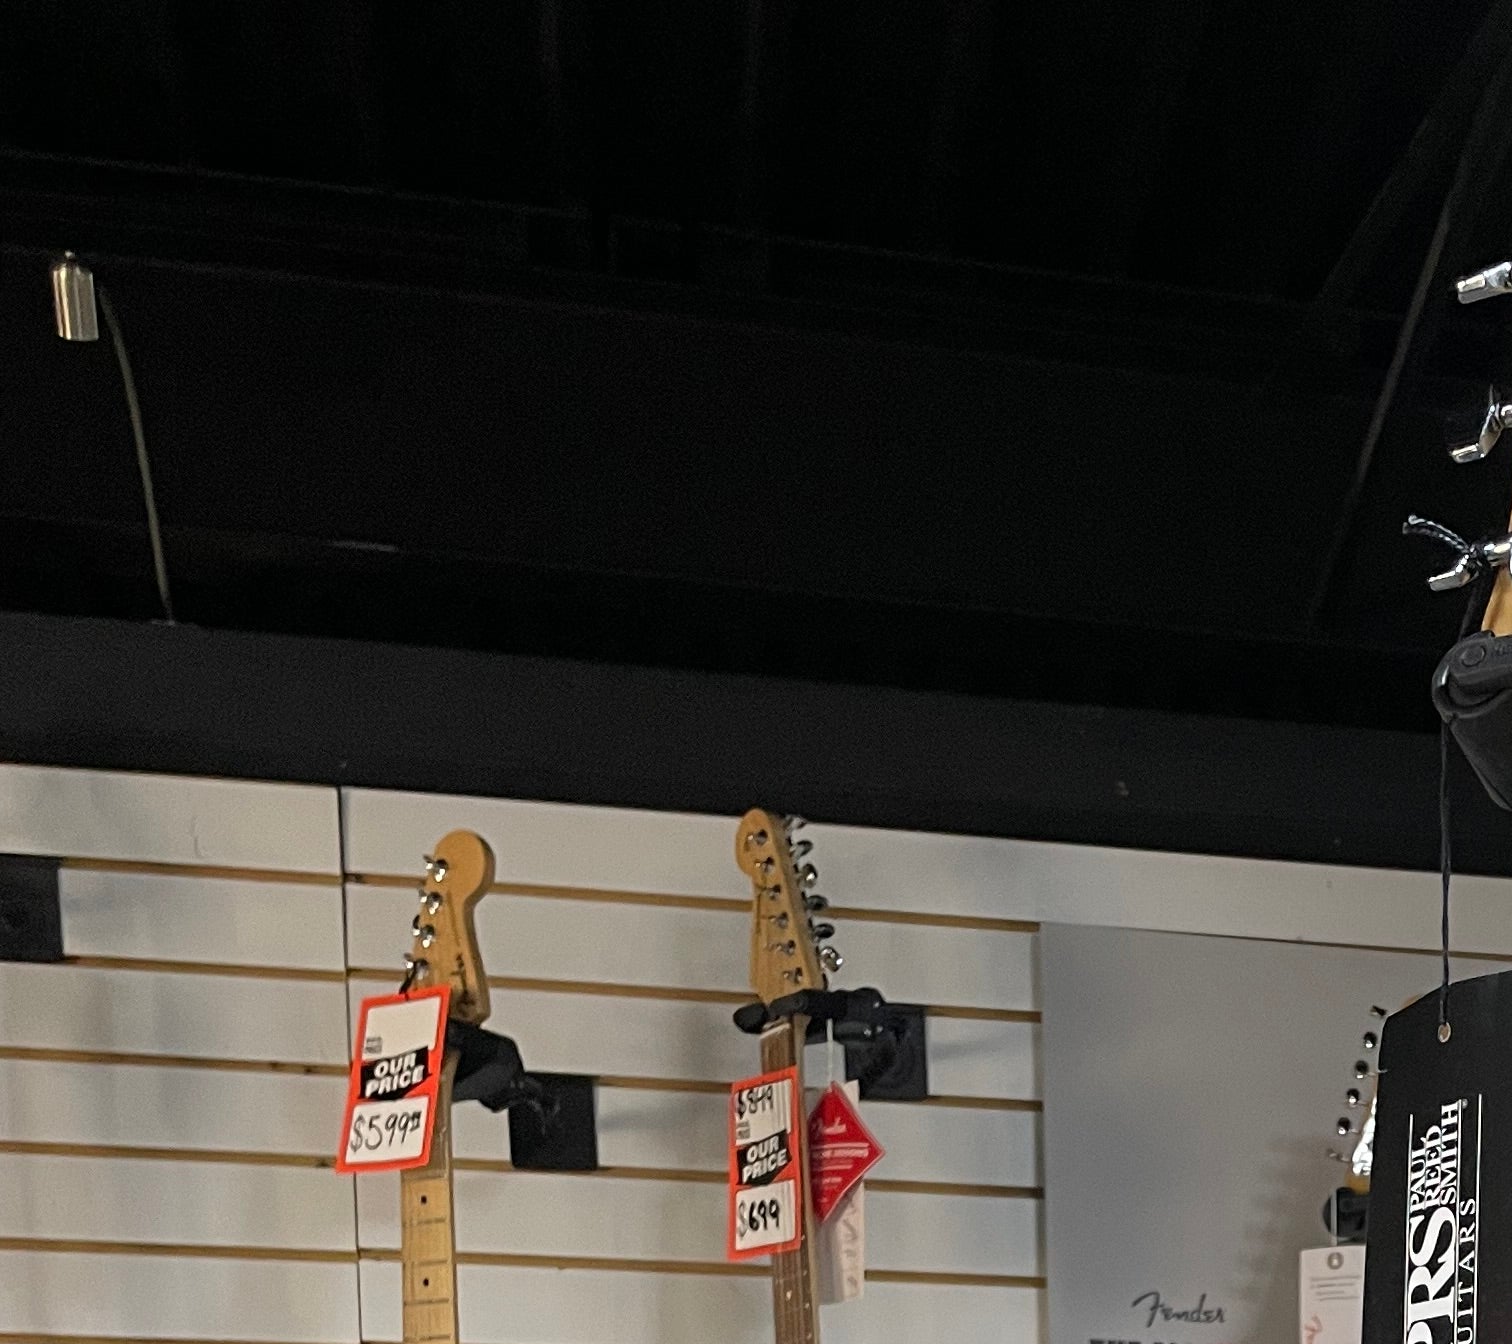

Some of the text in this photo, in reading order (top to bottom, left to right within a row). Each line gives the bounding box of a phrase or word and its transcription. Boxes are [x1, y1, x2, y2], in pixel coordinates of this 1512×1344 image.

[365, 1064, 425, 1099] PRICE
[374, 1052, 416, 1078] OUR
[742, 1149, 788, 1184] PRICE
[747, 1136, 780, 1163] OUR
[1424, 1125, 1441, 1210] REED
[1439, 1101, 1458, 1206] SMITH
[1410, 1137, 1427, 1214] PAUL
[1131, 1291, 1227, 1329] Fender
